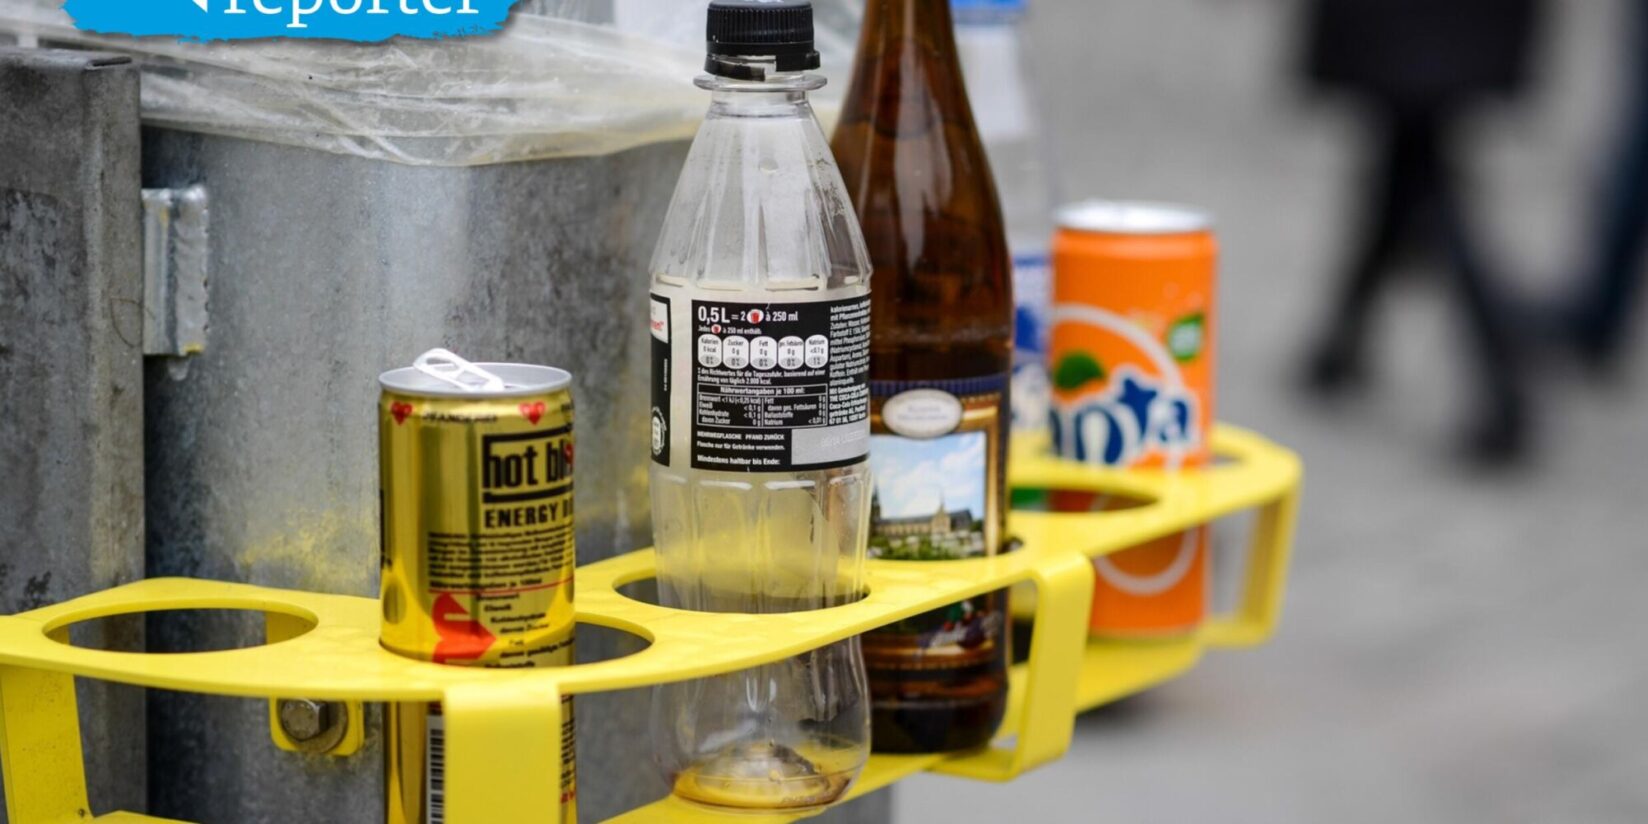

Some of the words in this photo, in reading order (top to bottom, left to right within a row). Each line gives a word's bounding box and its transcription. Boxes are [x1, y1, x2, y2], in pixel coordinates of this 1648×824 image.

[740, 312, 746, 321] 2
[766, 311, 771, 321] à
[772, 312, 786, 321] 250
[788, 311, 798, 321] ml
[720, 387, 774, 396] Nährwertangaben
[775, 388, 782, 396] je
[482, 441, 538, 489] hot
[697, 455, 729, 464] Mindestens
[729, 456, 751, 465] haltbar
[752, 457, 762, 465] bis
[485, 502, 559, 529] ENERGY
